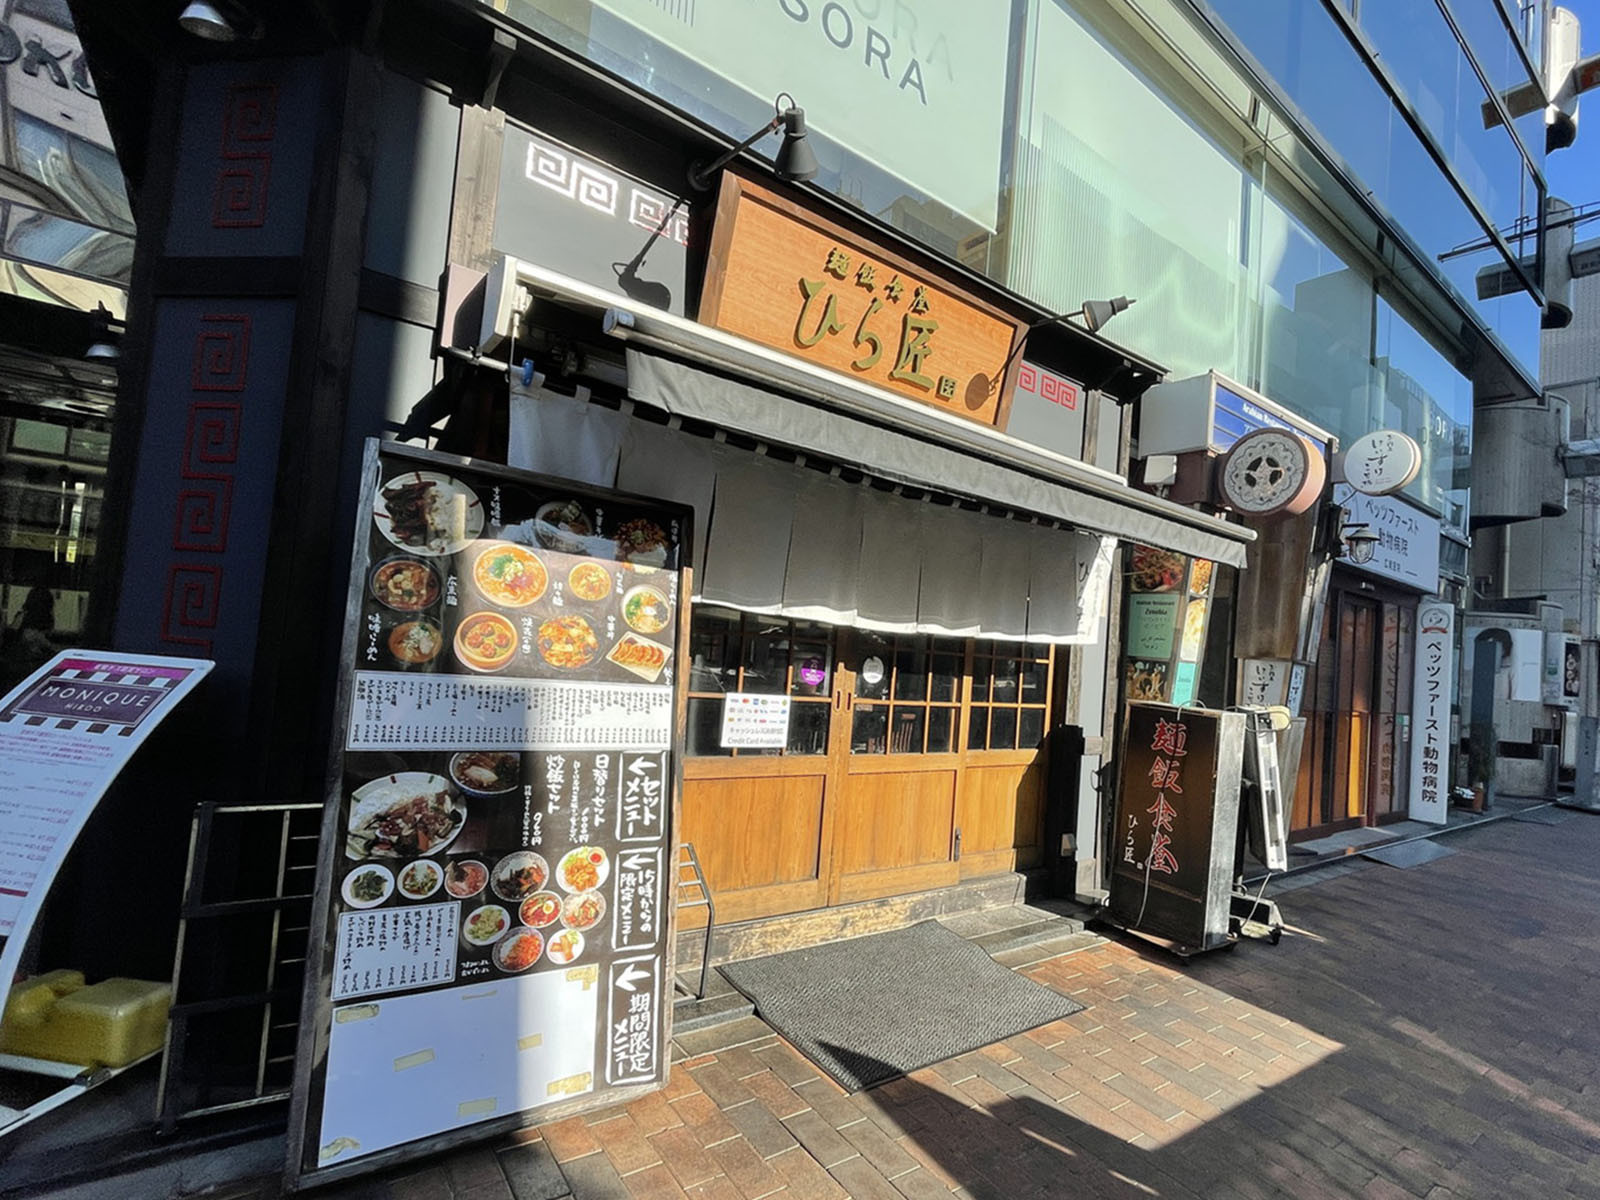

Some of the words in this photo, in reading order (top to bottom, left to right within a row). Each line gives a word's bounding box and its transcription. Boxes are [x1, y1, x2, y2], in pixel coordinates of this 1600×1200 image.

[794, 278, 939, 392] ひら匠
[1366, 500, 1419, 535] ペッツファースト
[41, 685, 153, 708] MONIQUE
[1421, 641, 1443, 804] ペッツファースト動物病院
[623, 777, 641, 836] メニュー
[641, 775, 660, 826] セット
[1146, 717, 1188, 874] 麺飯食堂
[1124, 815, 1138, 865] ひら匠
[620, 872, 637, 945] 限定メニュー
[638, 869, 656, 933] 15時からの
[613, 1018, 630, 1077] メニュー
[628, 992, 652, 1073] 期間限定
